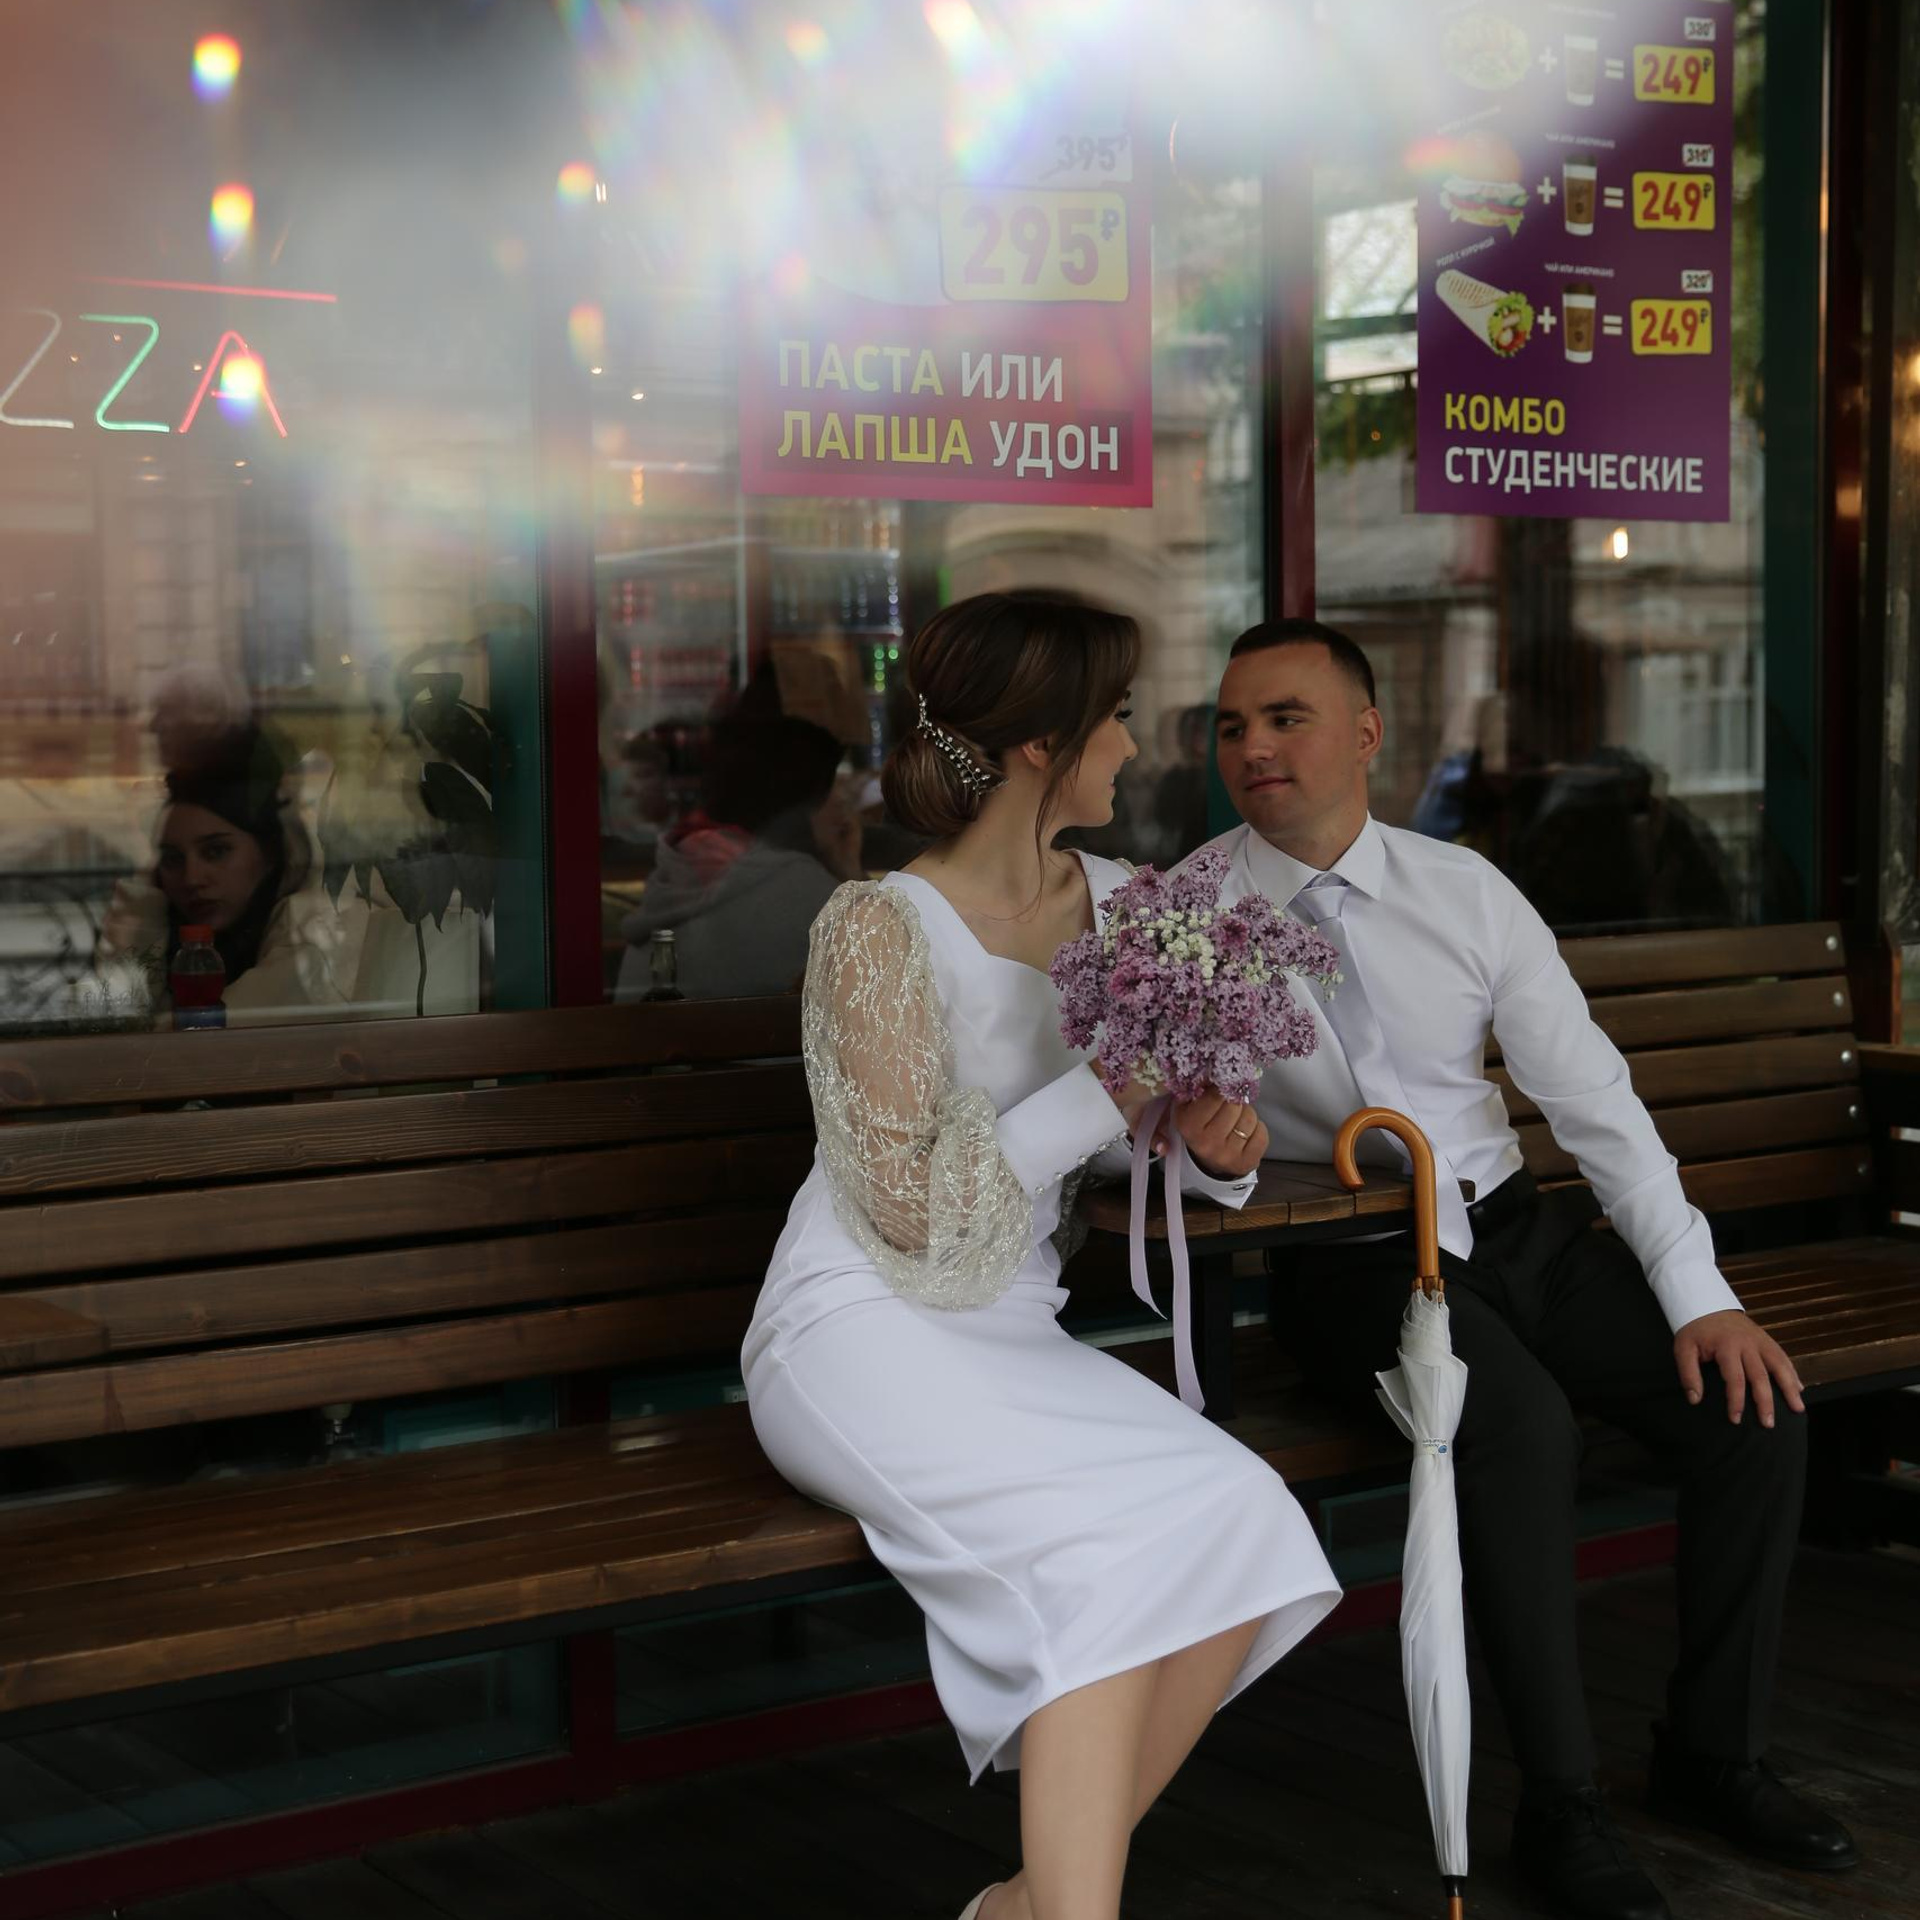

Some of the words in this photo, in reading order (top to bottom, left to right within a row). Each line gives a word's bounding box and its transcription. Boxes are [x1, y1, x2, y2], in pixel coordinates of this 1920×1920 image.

[778, 338, 944, 397] ПАСТА
[960, 351, 1063, 402] ИЛИ
[1444, 393, 1566, 436] КОМБО
[778, 409, 973, 465] ЛАПША
[989, 420, 1119, 479] УДОН
[1444, 446, 1703, 494] СТУДЕНЧЕСКИЕ
